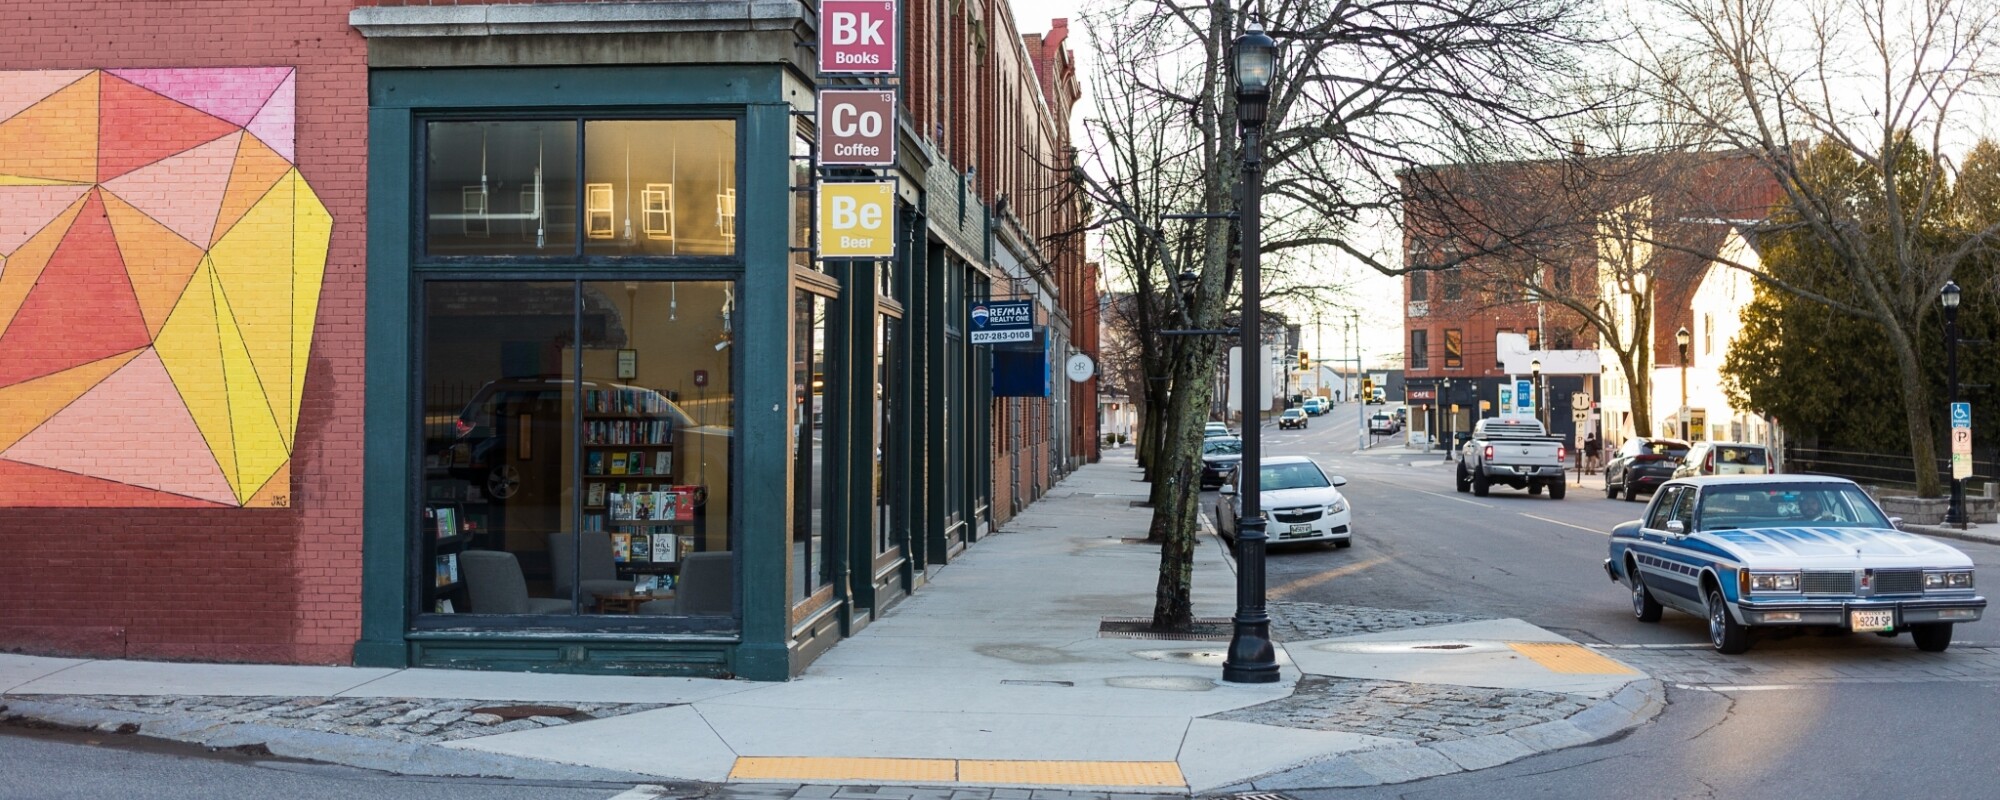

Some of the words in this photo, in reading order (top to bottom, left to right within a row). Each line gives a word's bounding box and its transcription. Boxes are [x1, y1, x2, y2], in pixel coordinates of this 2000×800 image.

[885, 2, 891, 11] 8
[832, 12, 885, 45] Bk
[835, 51, 879, 64] Books
[880, 93, 891, 102] 13
[831, 103, 882, 137] Co
[834, 143, 880, 156] Coffee
[880, 185, 890, 193] 21
[832, 196, 882, 230] Be
[840, 235, 873, 248] Beer
[990, 306, 1029, 317] RE/MAX
[974, 331, 1030, 341] 207-283-0108
[1860, 616, 1879, 627] 9224
[1881, 616, 1891, 626] SP
